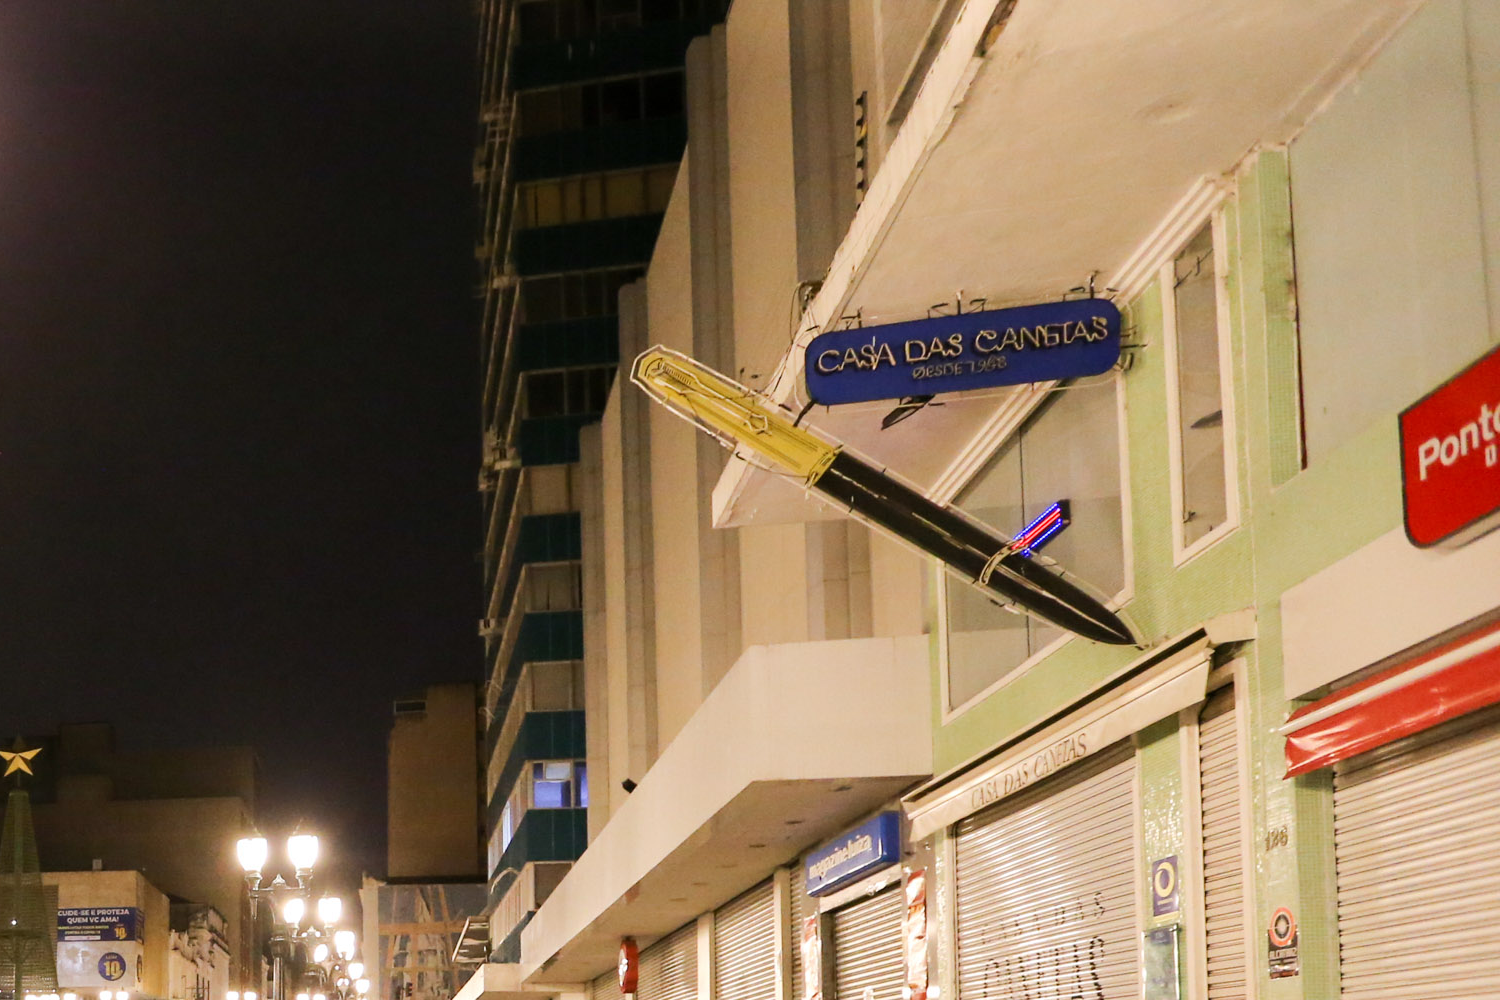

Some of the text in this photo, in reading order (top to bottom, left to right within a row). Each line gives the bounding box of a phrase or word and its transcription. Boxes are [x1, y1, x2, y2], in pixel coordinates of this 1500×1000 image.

[817, 316, 1109, 374] CASA DAS CANETAS
[971, 732, 1088, 810] CASA DAS CANETAS
